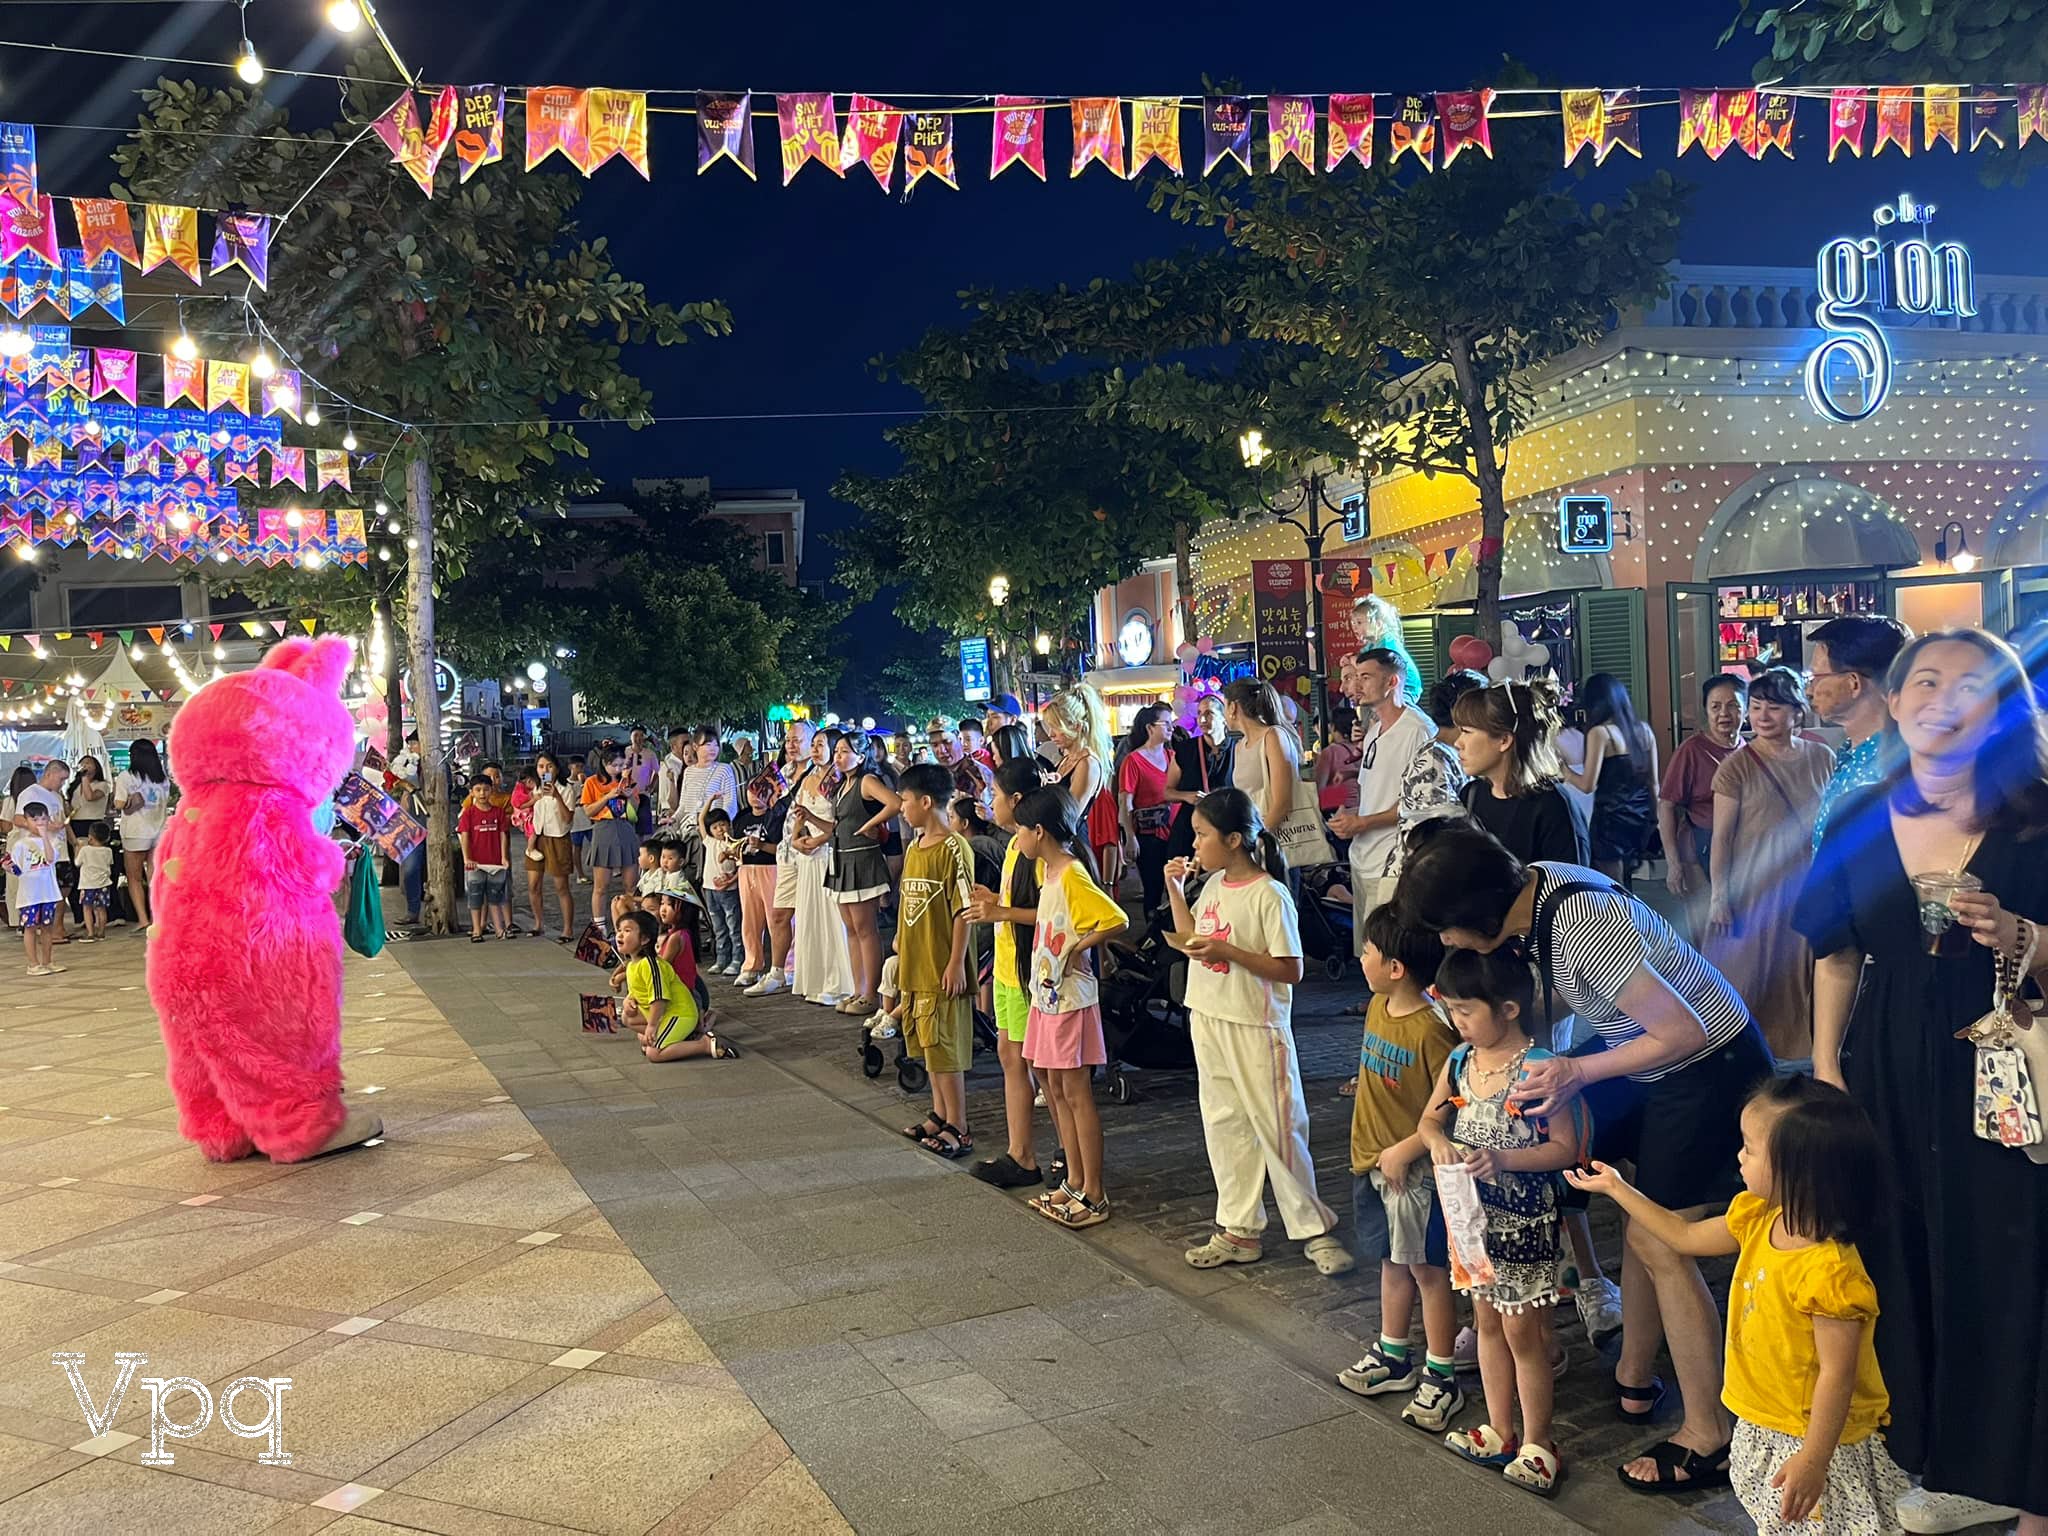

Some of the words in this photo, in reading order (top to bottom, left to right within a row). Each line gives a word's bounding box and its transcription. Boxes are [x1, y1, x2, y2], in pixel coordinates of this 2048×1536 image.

[1898, 193, 1937, 223] bar
[1804, 237, 1978, 424] gion
[1261, 606, 1302, 623] 맛있는
[1261, 622, 1303, 637] 야시장
